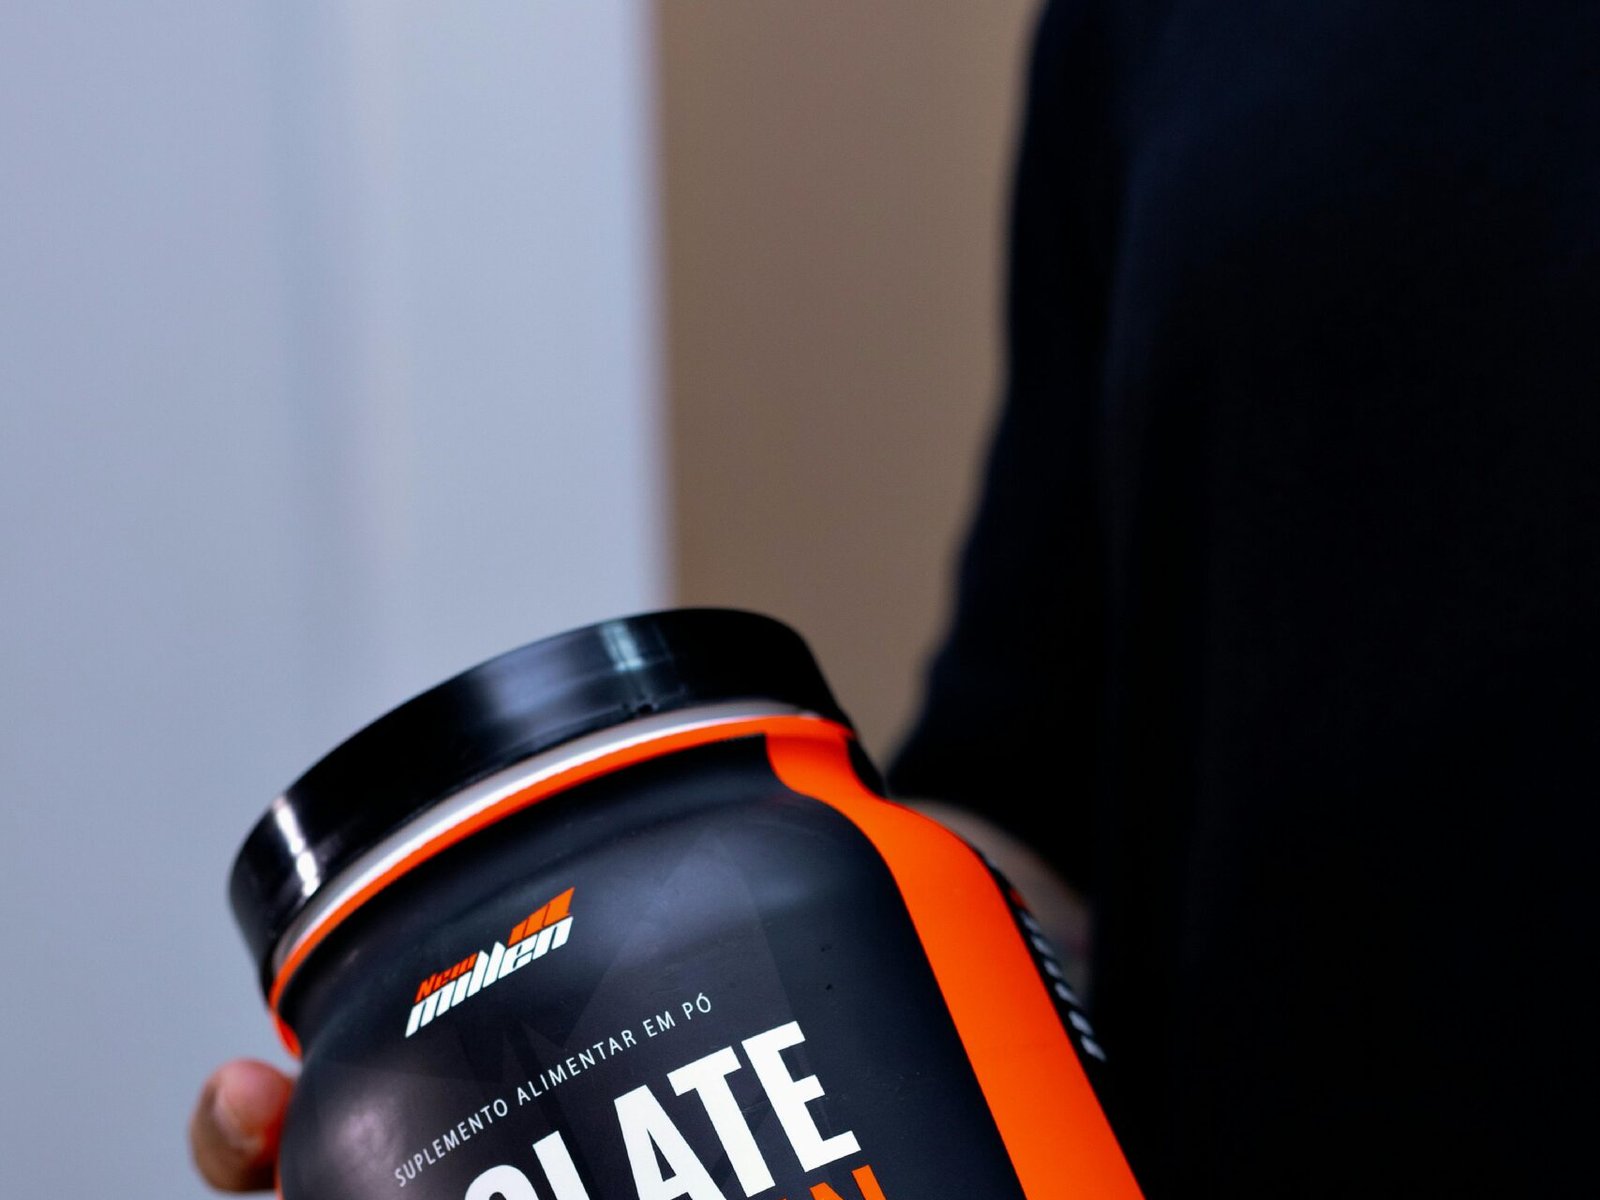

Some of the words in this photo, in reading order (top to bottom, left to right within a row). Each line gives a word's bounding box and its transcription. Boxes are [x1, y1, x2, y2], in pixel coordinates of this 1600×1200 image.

[395, 1098, 509, 1188] SUPLEMENTO
[516, 1029, 637, 1106] ALIMENTAR
[643, 1009, 676, 1038] EM
[682, 992, 713, 1021] PÓ
